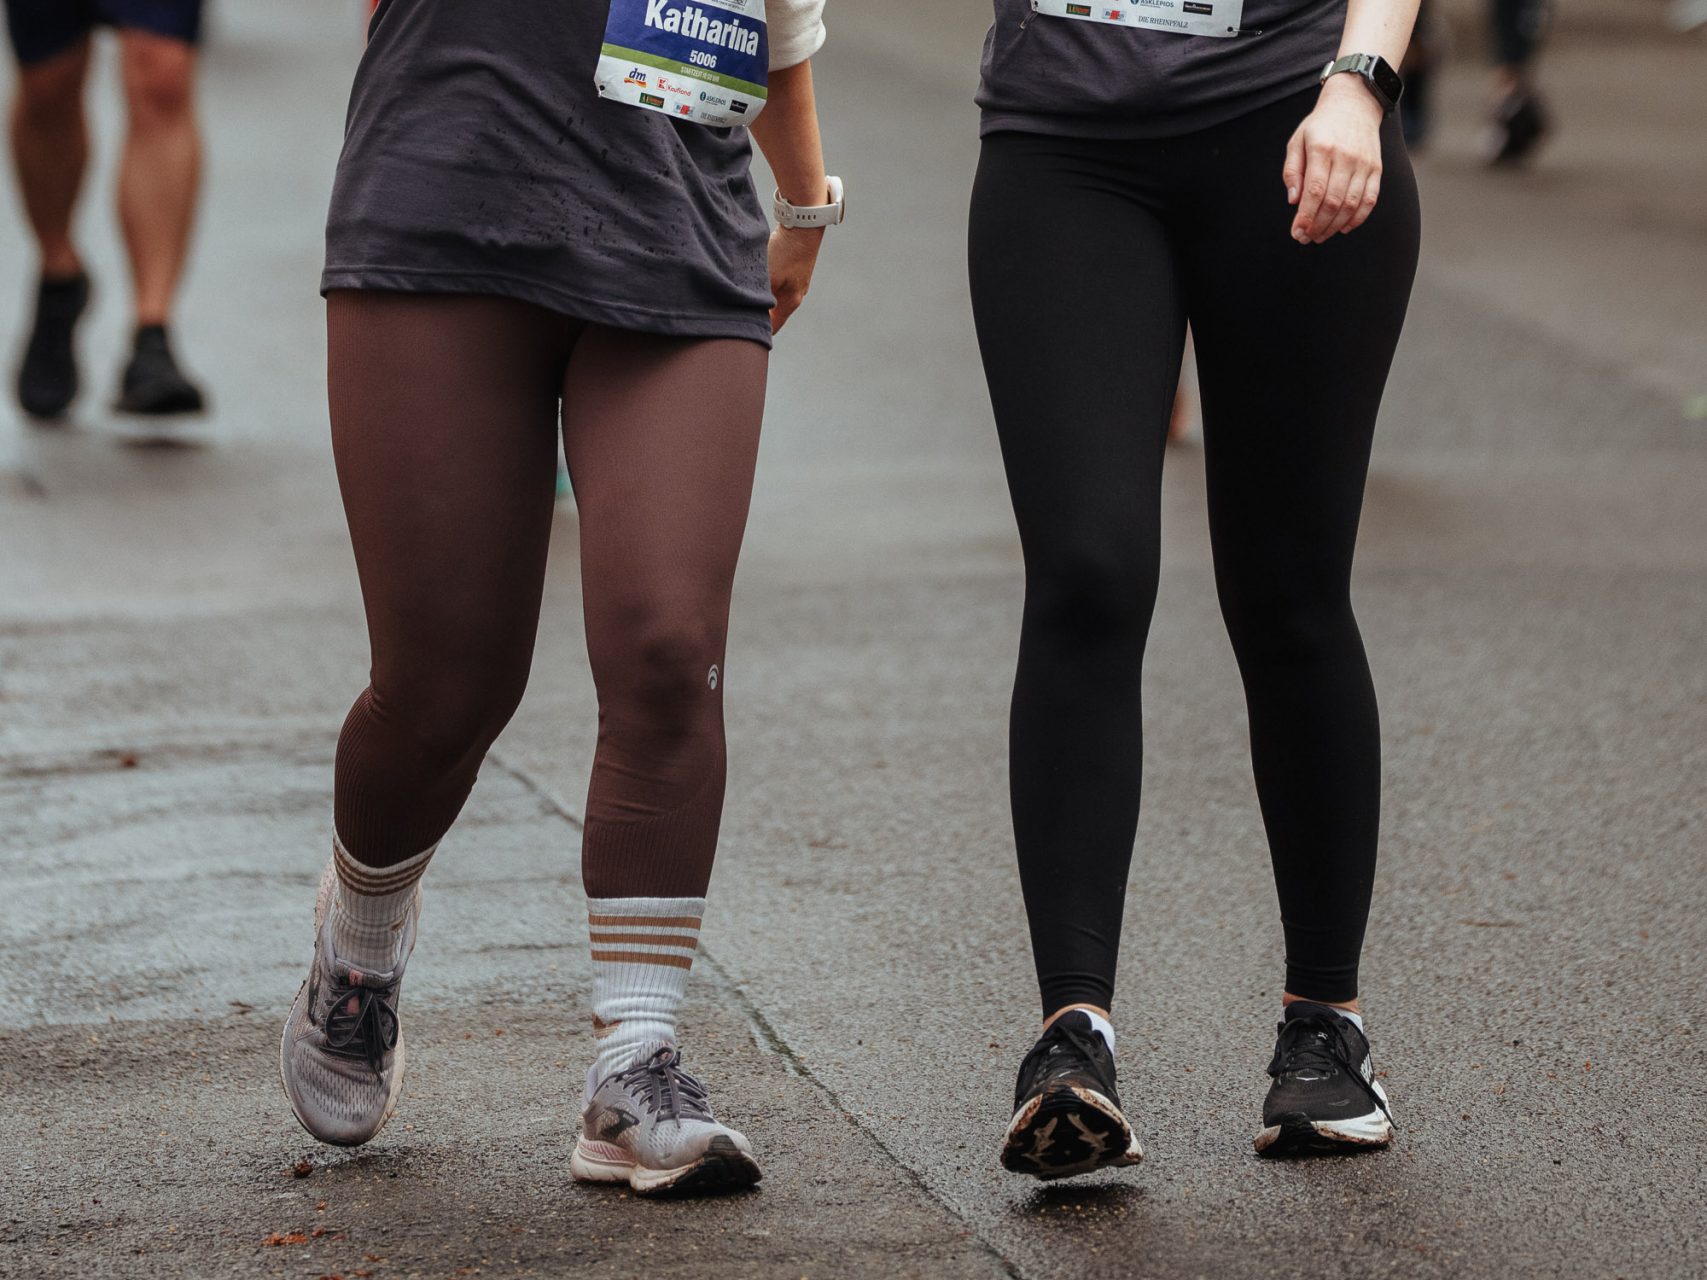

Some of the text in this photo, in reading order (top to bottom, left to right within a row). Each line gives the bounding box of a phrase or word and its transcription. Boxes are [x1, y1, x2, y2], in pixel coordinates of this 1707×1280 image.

[1150, 17, 1189, 29] RHEINPFALZ
[689, 50, 718, 69] 5006
[629, 67, 646, 81] dm
[667, 85, 691, 97] Kaufland
